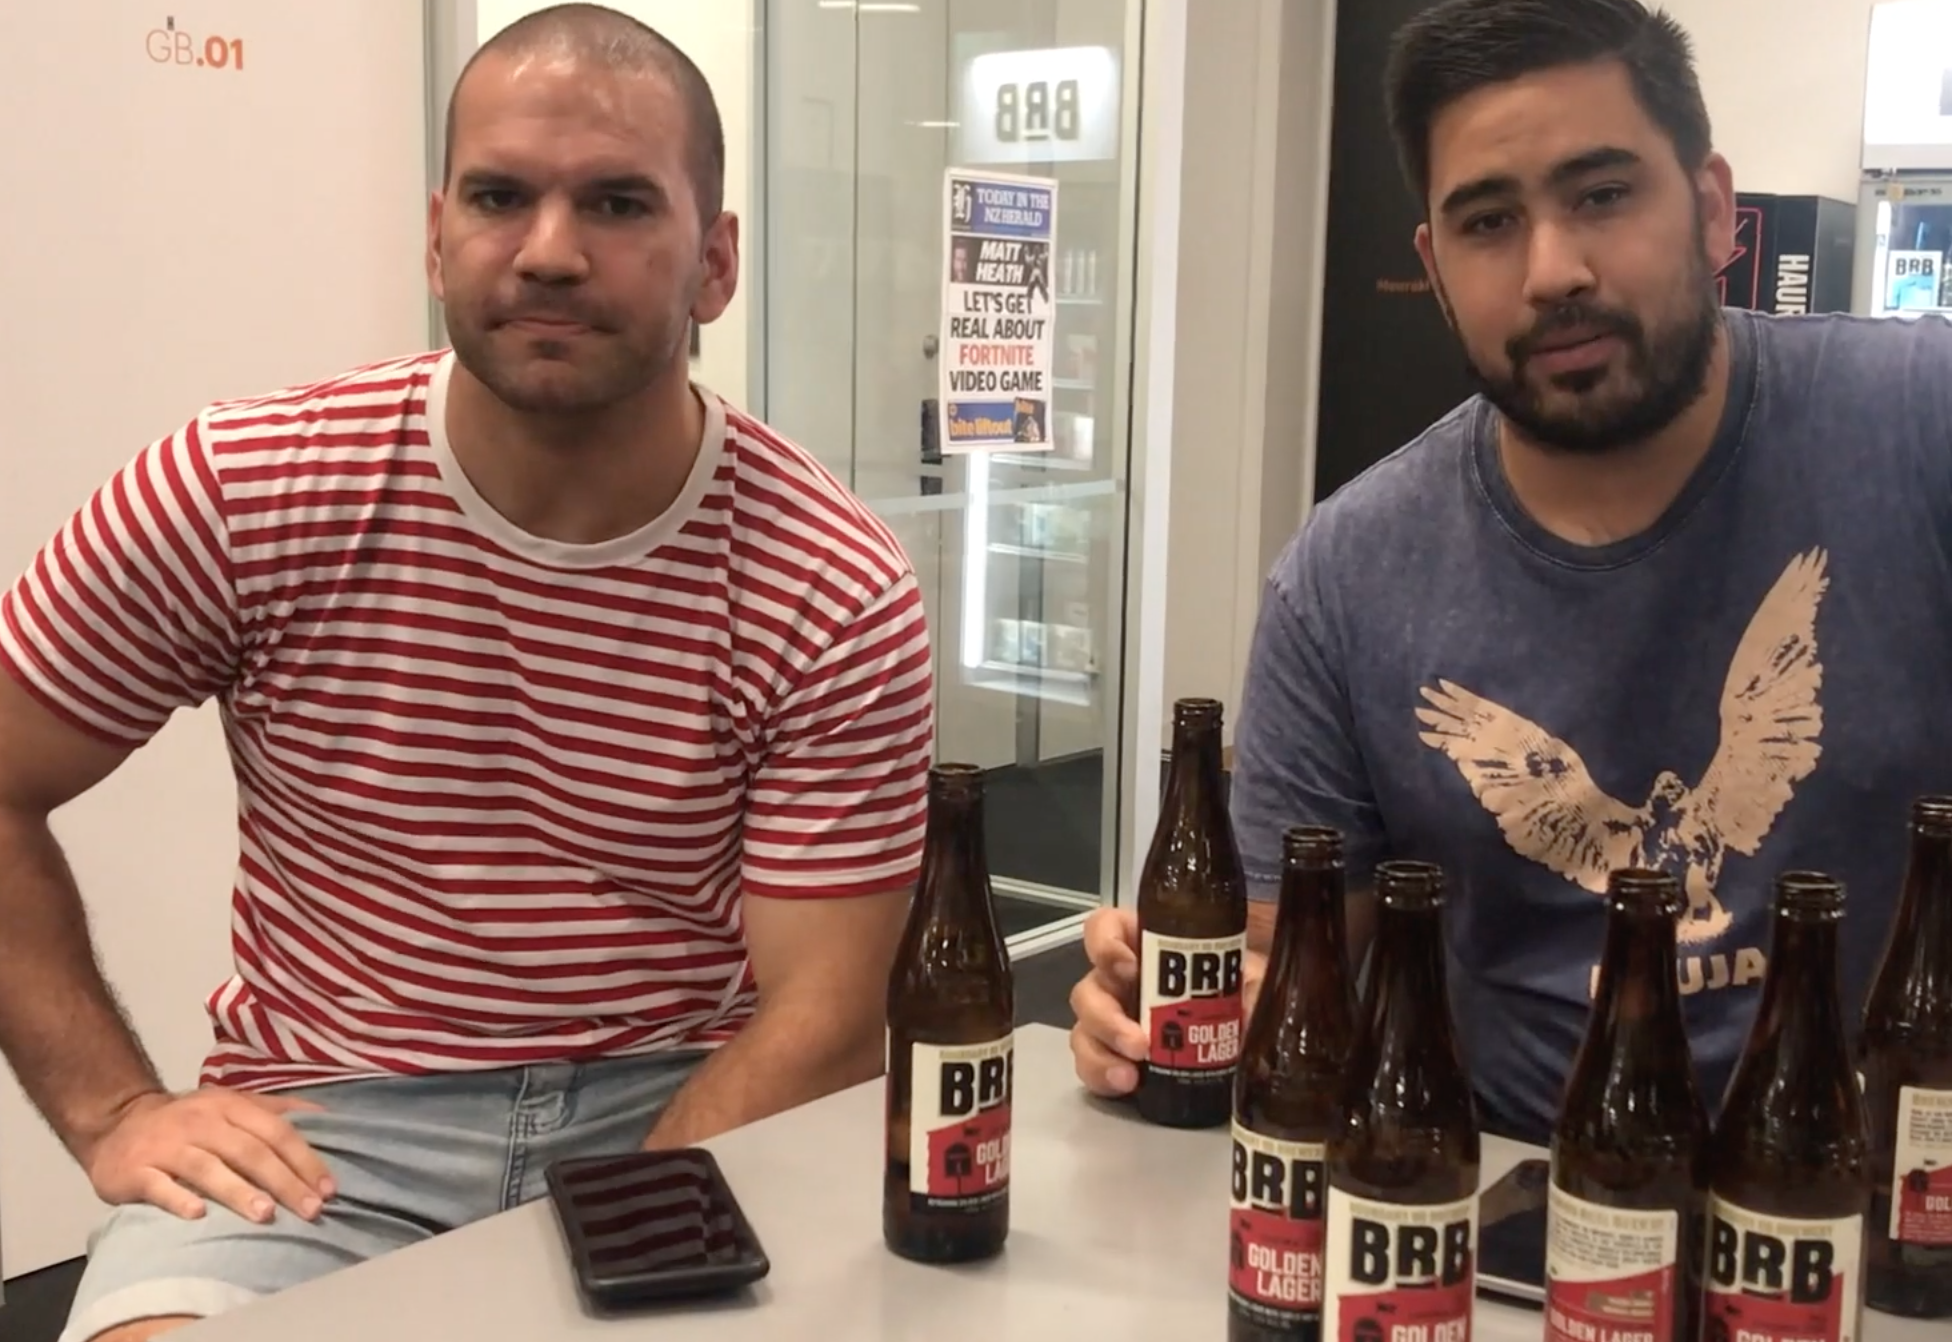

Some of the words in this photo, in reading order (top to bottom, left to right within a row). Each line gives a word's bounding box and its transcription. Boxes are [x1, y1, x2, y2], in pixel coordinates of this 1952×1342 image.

[146, 29, 243, 70] GB.01
[976, 188, 1016, 206] TODAY
[1017, 192, 1028, 208] IN
[1030, 193, 1049, 210] THE
[980, 240, 1022, 262] MATT
[975, 261, 1024, 284] HEATH
[1896, 258, 1934, 276] BRB
[964, 290, 1003, 313] LET'S
[1005, 292, 1032, 314] GET
[950, 317, 989, 338] REAL
[993, 318, 1045, 340] ABOUT
[960, 344, 1034, 366] FORTNITE
[949, 371, 997, 392] VIDEO
[1000, 371, 1043, 392] GAME
[1158, 950, 1242, 998] BRB
[1188, 1019, 1239, 1044] GOLDEN
[1198, 1039, 1239, 1063] LAGER
[1232, 1138, 1323, 1220] BRB
[1248, 1242, 1321, 1278] GOLDEN
[1351, 1217, 1471, 1287] BRB
[1711, 1214, 1834, 1304] BRB
[1257, 1271, 1321, 1302] LAGER
